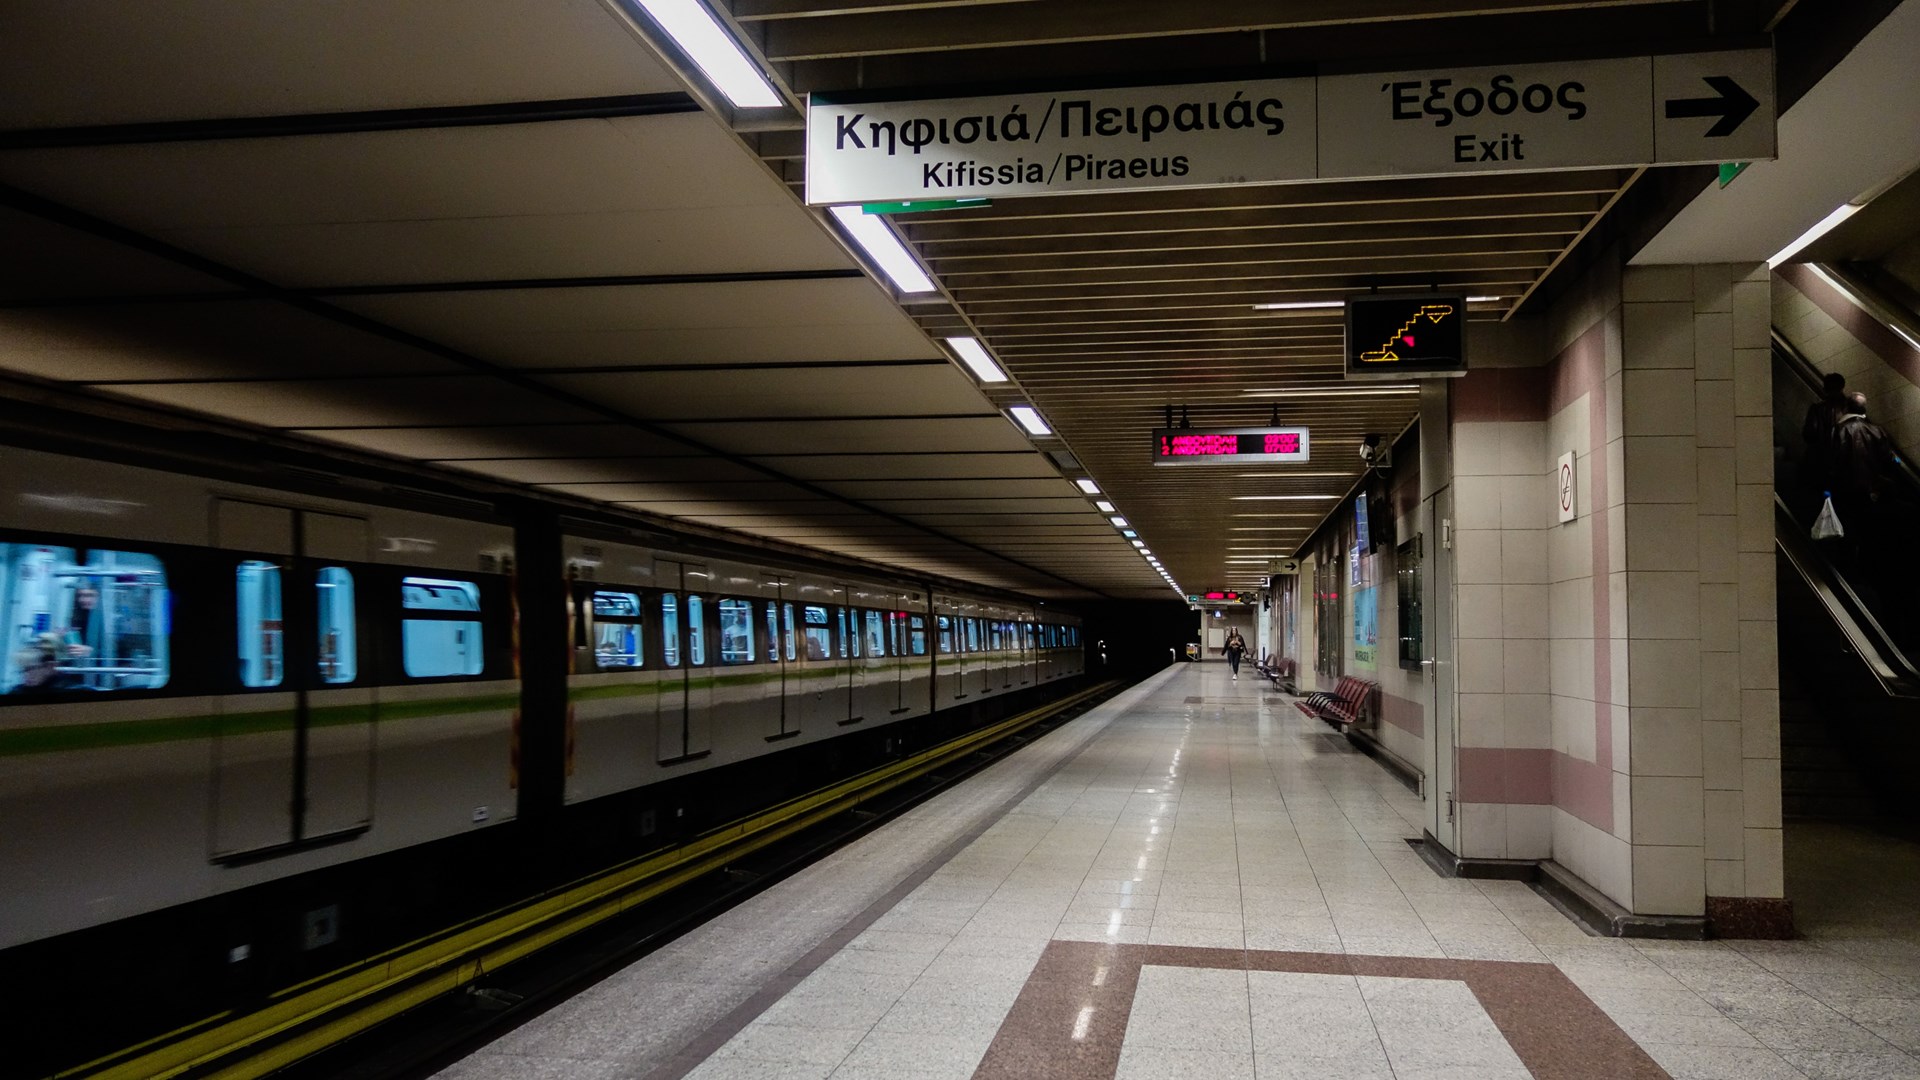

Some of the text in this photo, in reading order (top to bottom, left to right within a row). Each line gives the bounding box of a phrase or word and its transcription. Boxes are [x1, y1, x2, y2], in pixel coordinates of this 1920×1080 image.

[1381, 75, 1587, 127] Έξοδος
[836, 91, 1285, 156] Κηφισιά/Πειραιάς
[1454, 133, 1524, 163] Exit
[923, 152, 1189, 188] Kifissia/Piraeus
[1161, 445, 1170, 455] 2
